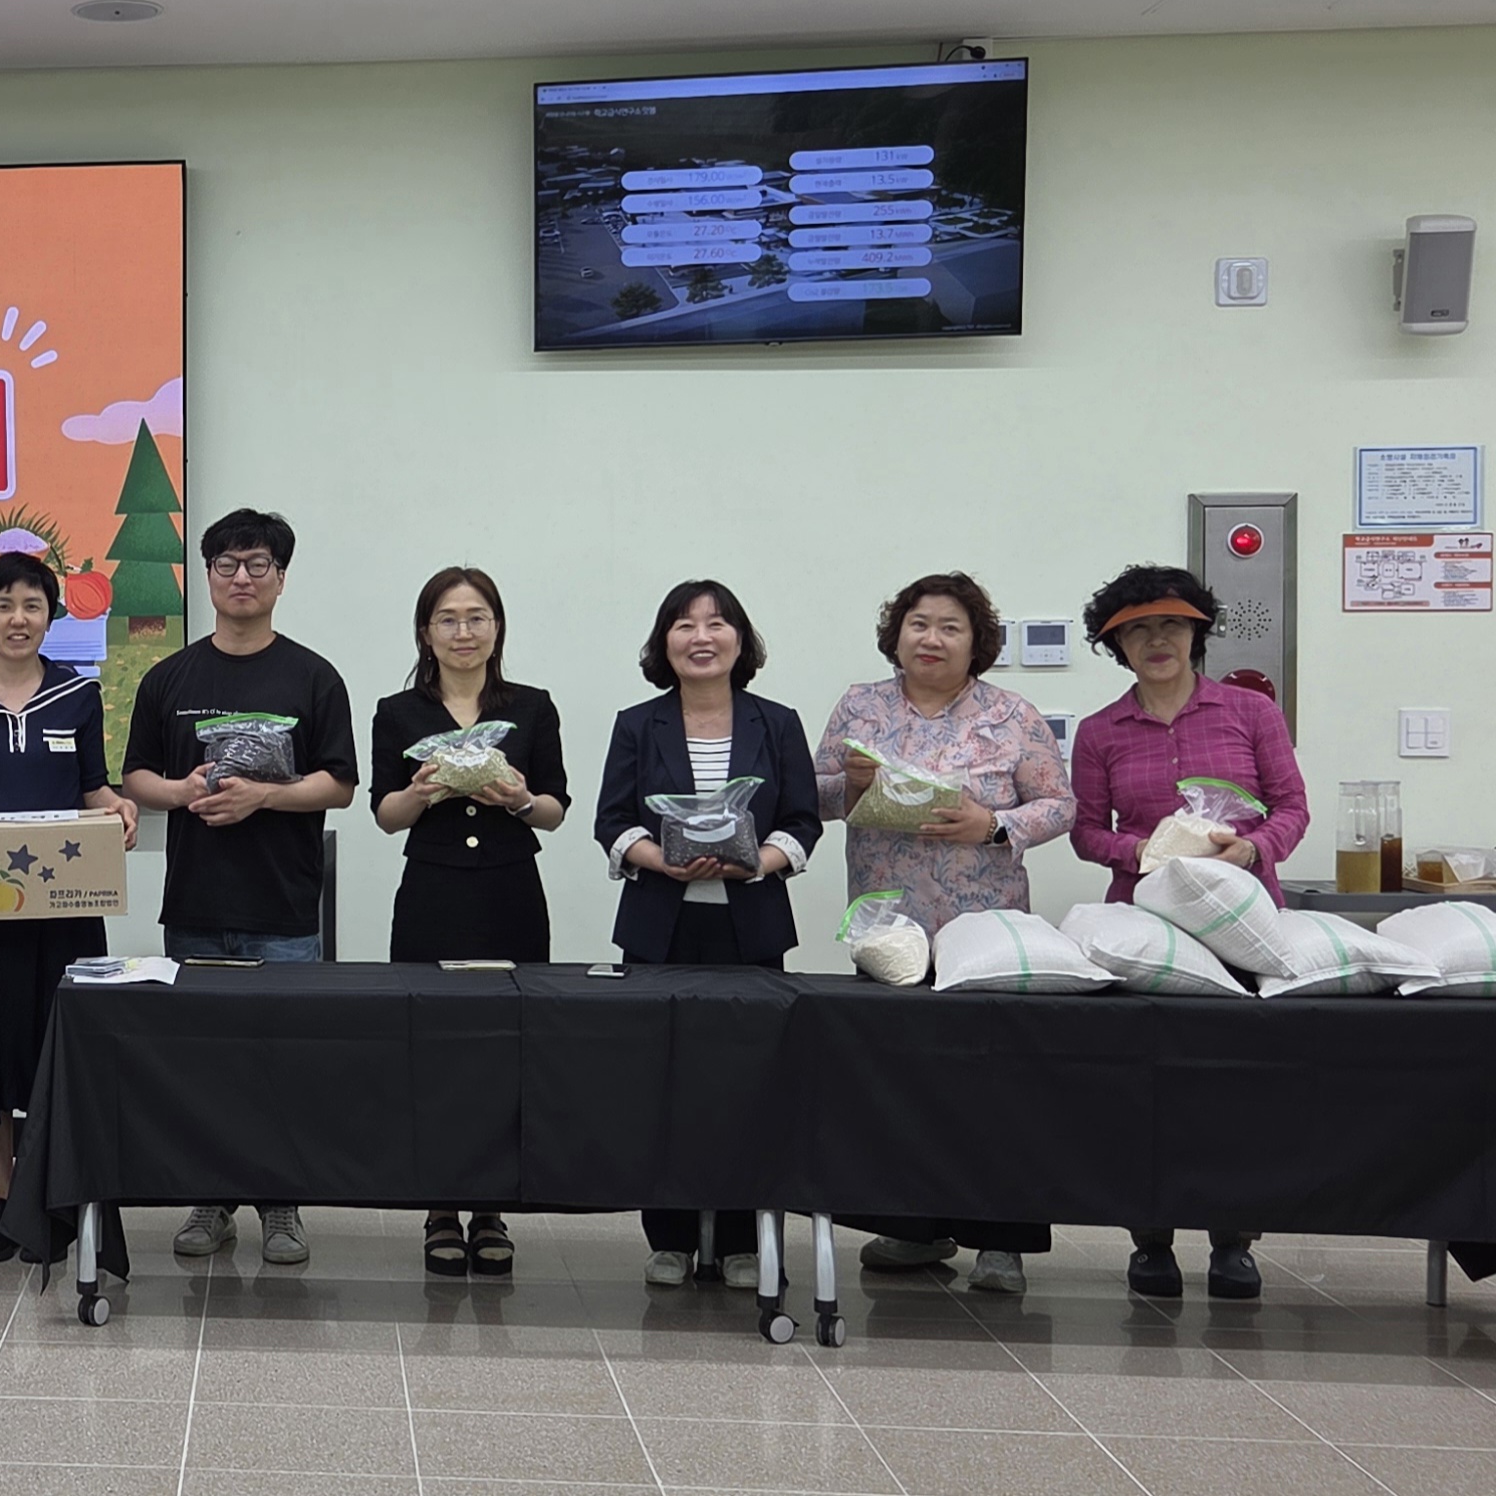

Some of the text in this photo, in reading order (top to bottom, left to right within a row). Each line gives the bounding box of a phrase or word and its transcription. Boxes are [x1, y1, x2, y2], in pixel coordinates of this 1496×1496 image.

[875, 151, 894, 162] 131
[871, 175, 895, 185] 13.5
[873, 206, 894, 216] 255
[693, 224, 725, 237] 27.20
[870, 228, 894, 239] 13.7
[693, 247, 725, 260] 27.60
[861, 251, 894, 263] 409.2
[89, 889, 119, 898] PAPRIKA
